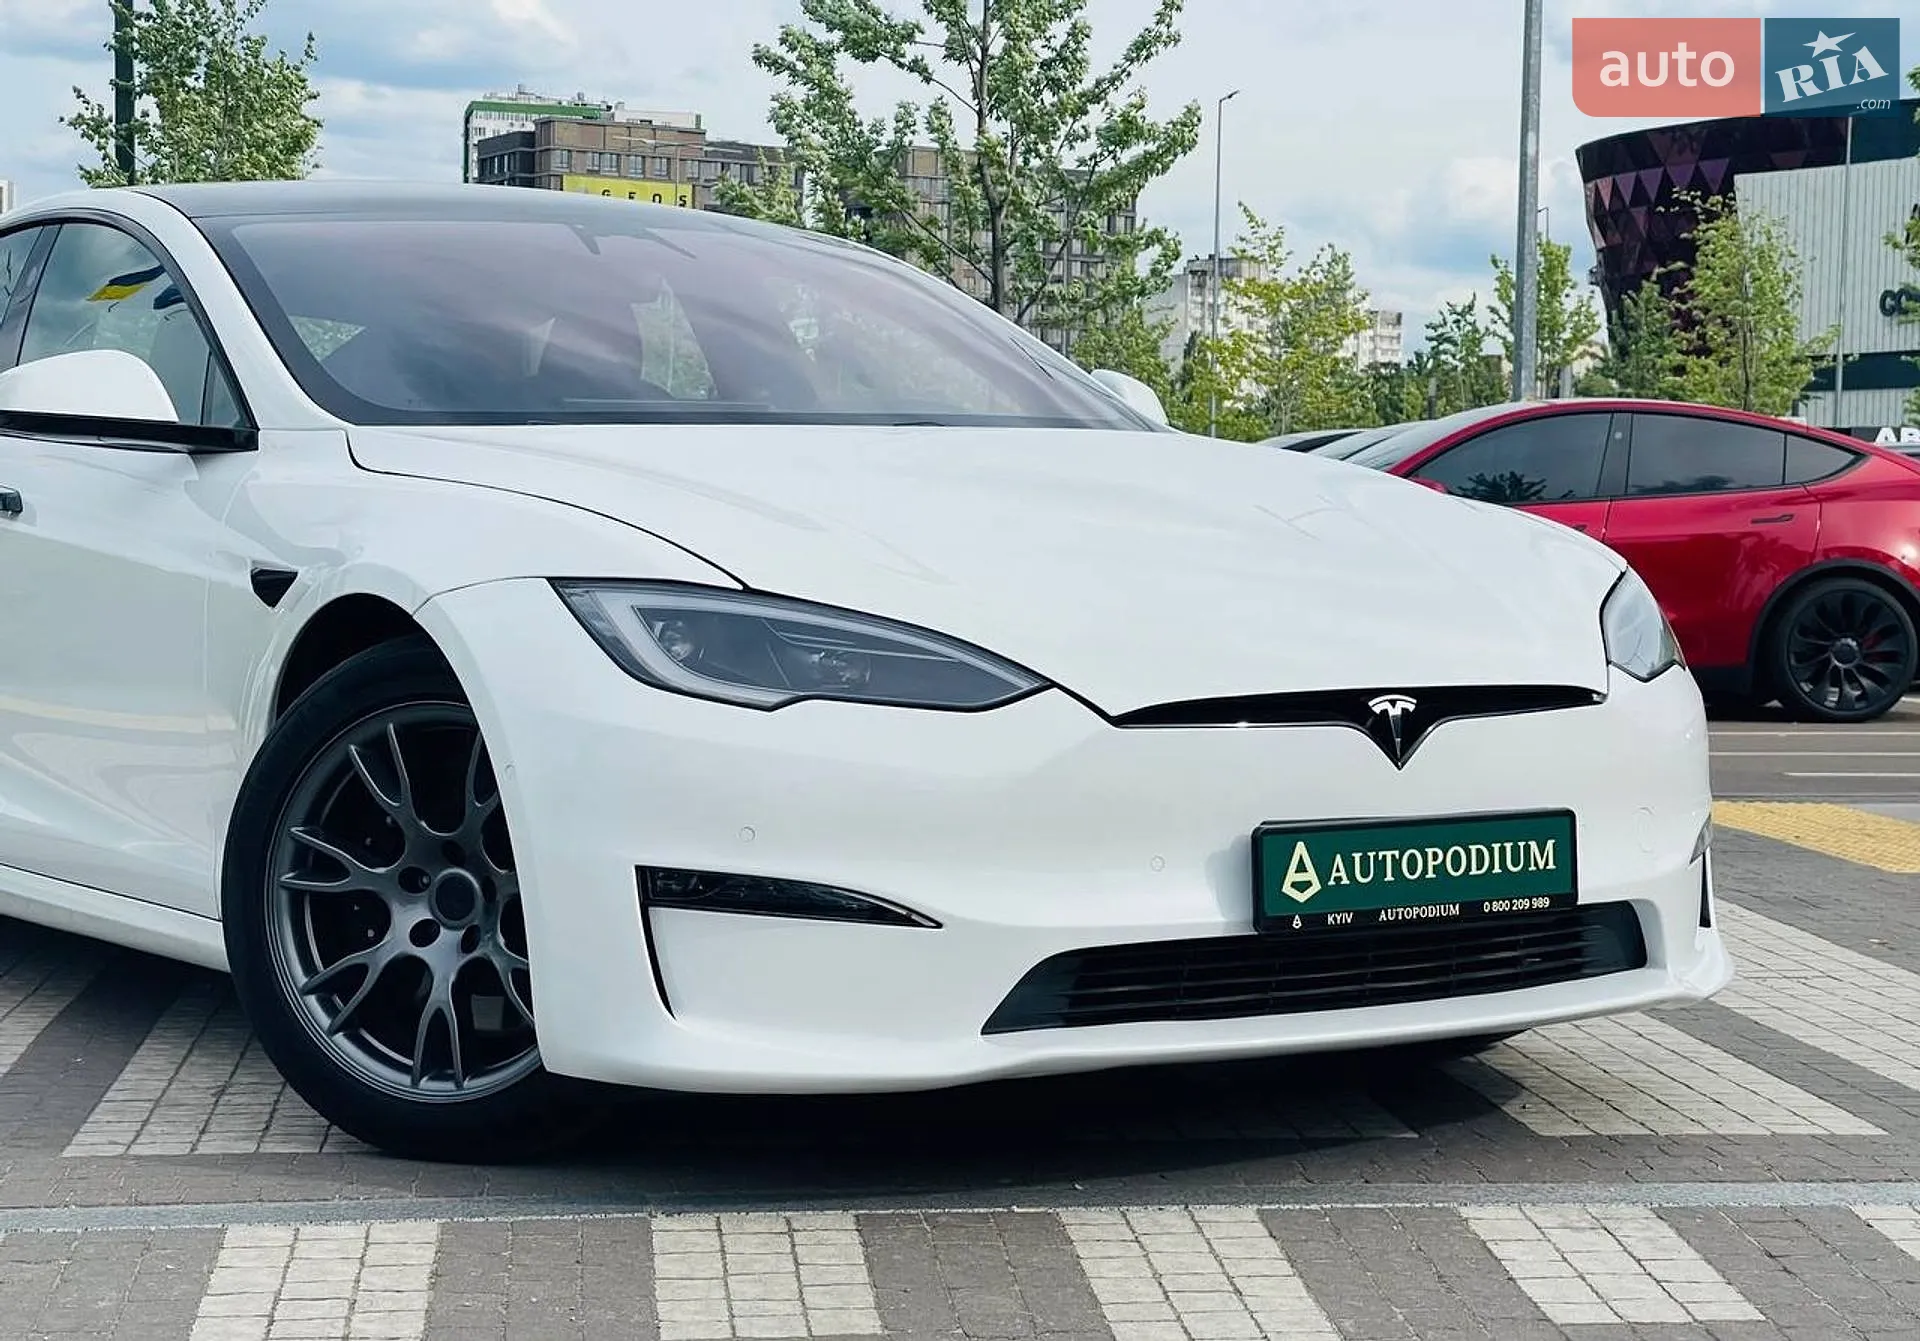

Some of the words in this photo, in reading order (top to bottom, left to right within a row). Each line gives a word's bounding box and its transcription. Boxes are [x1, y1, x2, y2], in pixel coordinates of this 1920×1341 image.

[1327, 840, 1556, 886] AUTOPODIUM
[1327, 912, 1354, 926] KYIV
[1378, 903, 1460, 922] AUTOPODIUM
[1483, 901, 1491, 913] 0
[1491, 900, 1511, 912] 800
[1512, 898, 1530, 910] 209
[1531, 896, 1550, 909] 989
